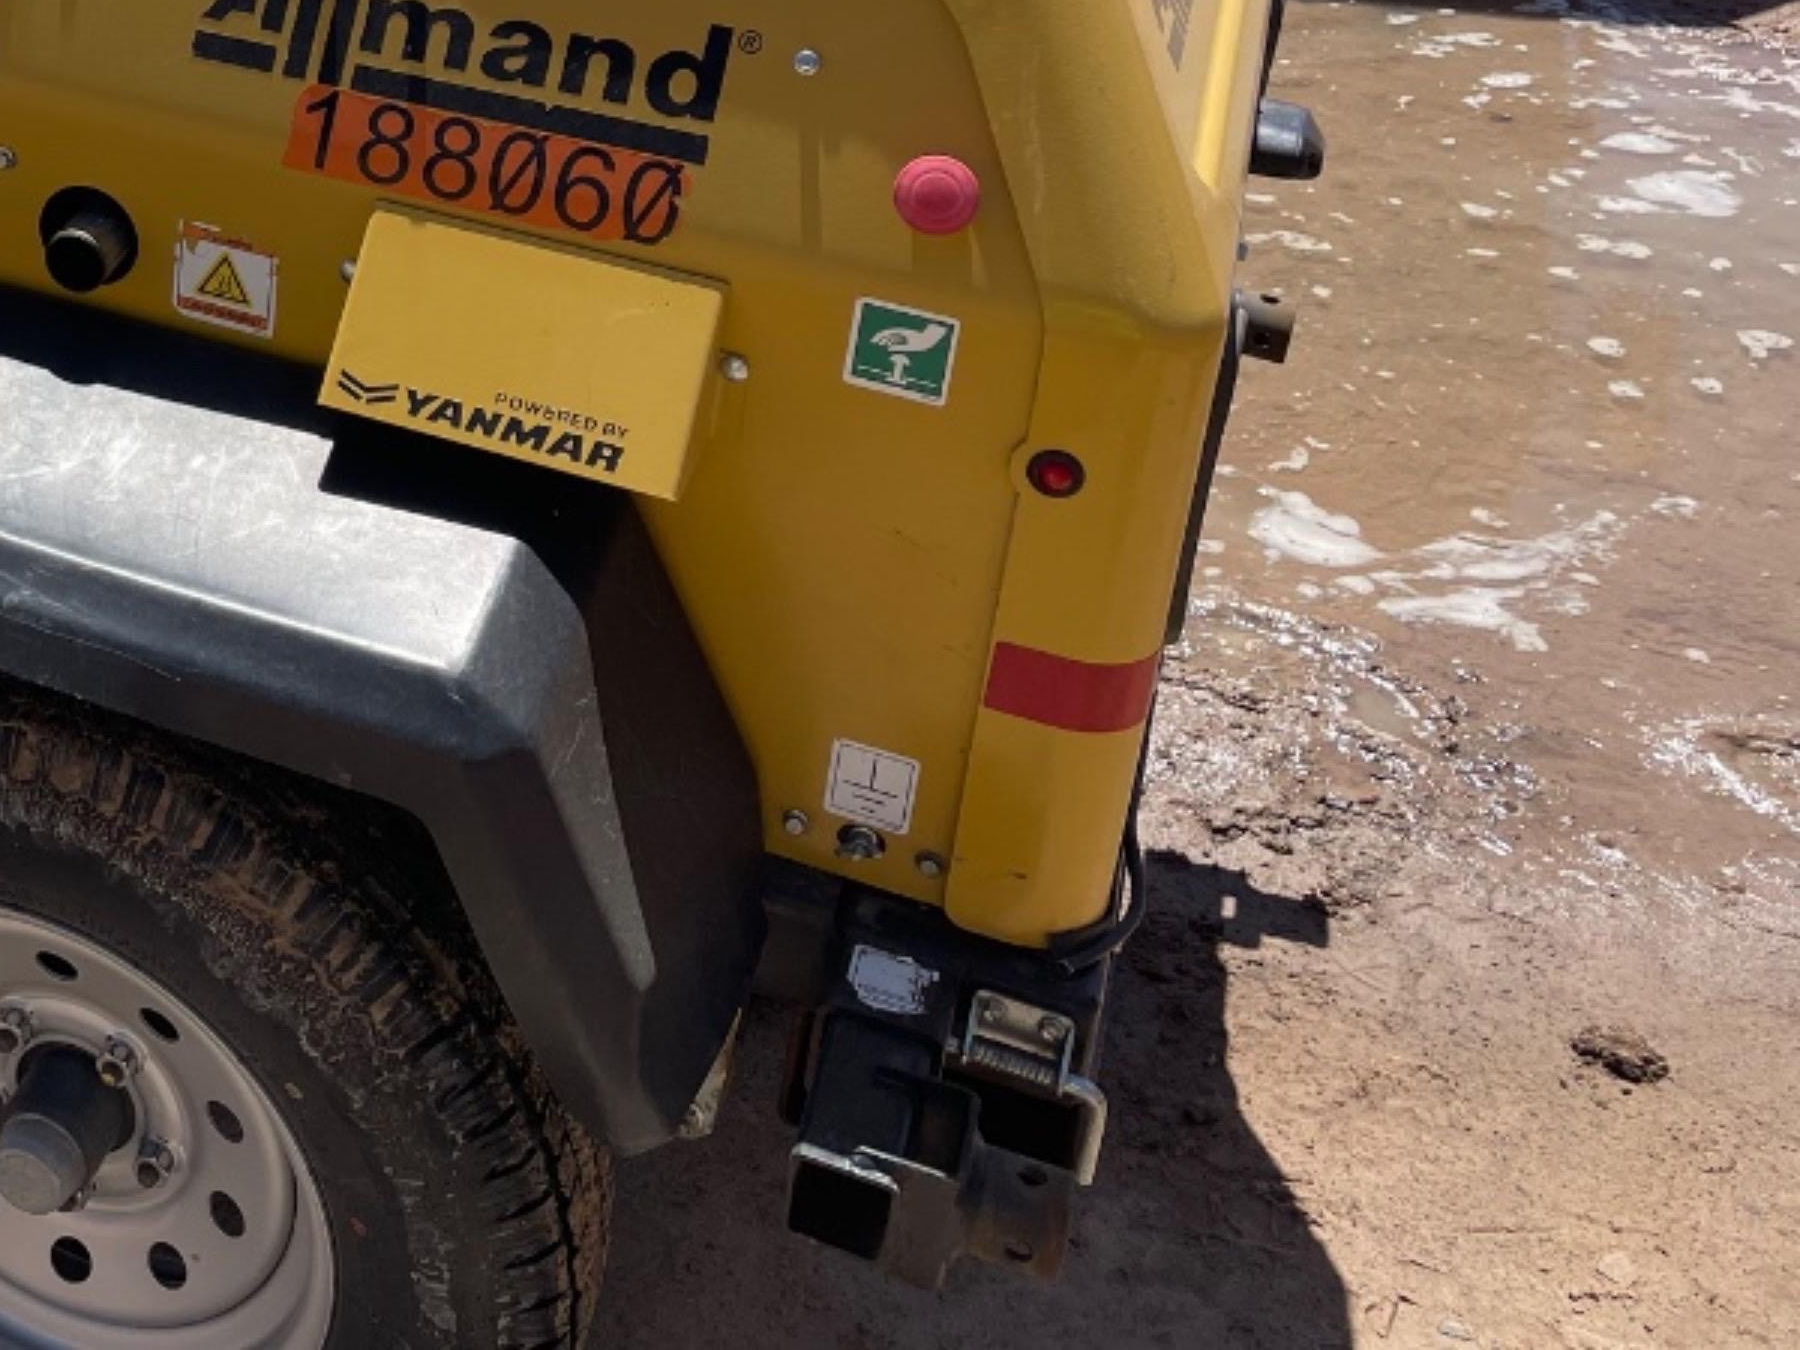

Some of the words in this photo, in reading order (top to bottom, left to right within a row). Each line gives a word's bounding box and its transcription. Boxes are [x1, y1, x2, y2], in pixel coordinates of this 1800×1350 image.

[406, 388, 626, 474] YANMAR
[495, 391, 599, 433] POWERED
[602, 419, 629, 439] BY
